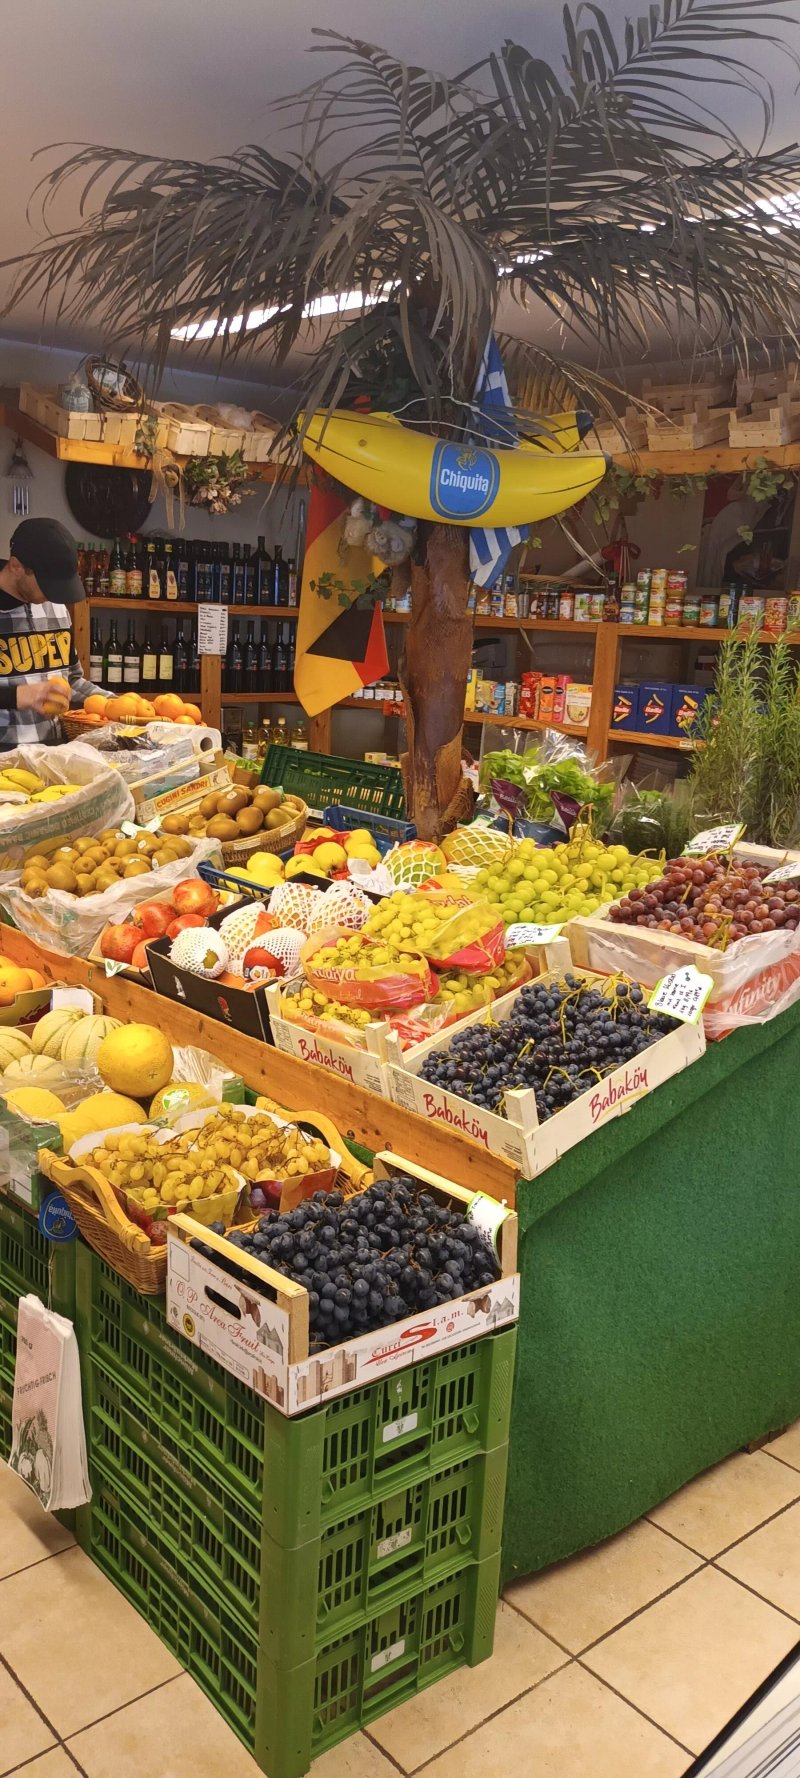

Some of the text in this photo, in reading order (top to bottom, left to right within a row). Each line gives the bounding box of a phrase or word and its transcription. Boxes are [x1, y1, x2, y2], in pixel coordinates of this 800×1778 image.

[440, 468, 490, 496] Chiquita
[156, 780, 208, 808] CUGINI SANDRI
[298, 1038, 356, 1086] Babaköy
[588, 1066, 649, 1124] Babaköy
[423, 1093, 490, 1150] Babaköy
